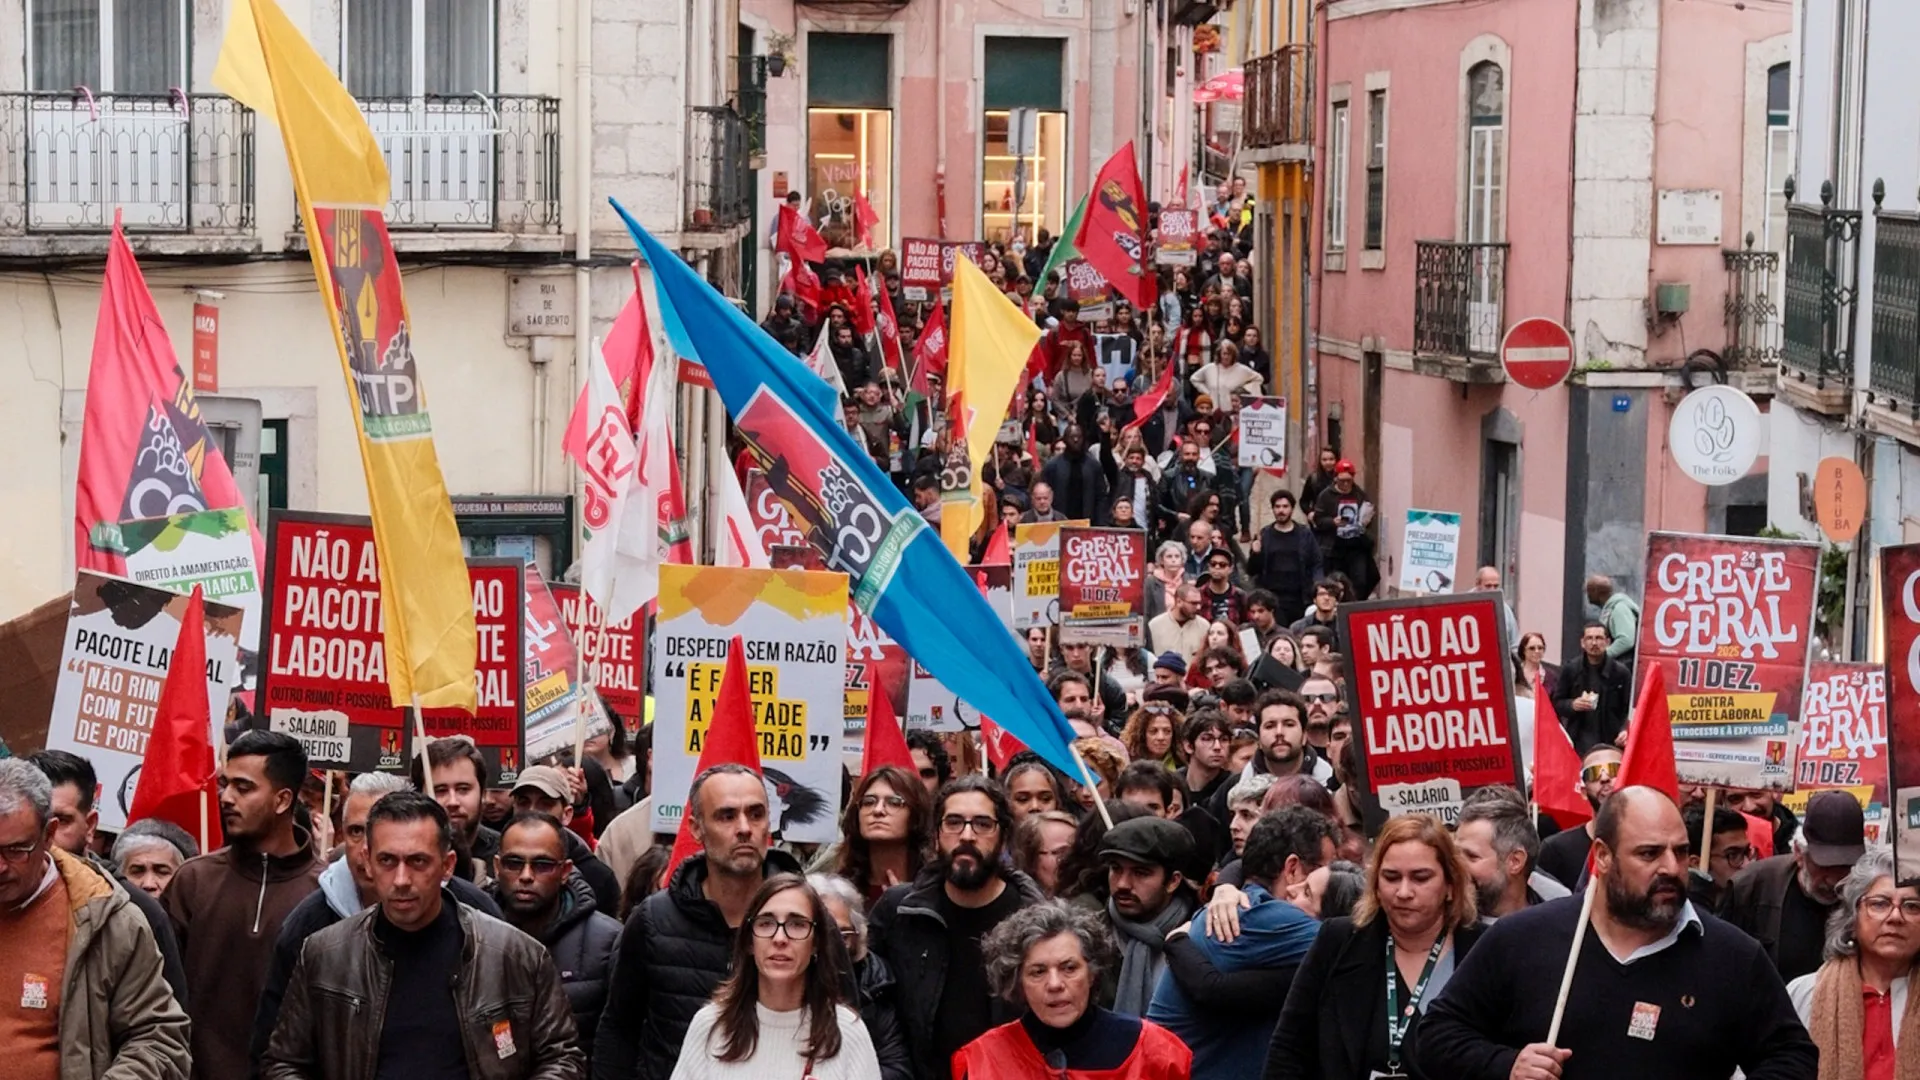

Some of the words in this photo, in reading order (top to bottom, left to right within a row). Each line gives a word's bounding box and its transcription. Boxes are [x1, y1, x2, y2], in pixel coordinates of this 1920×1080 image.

[908, 242, 926, 255] NÃO
[927, 244, 939, 256] AO
[907, 255, 939, 268] PACOTE
[903, 267, 941, 281] LABORAL
[540, 284, 556, 294] RUA
[543, 300, 552, 310] DE
[545, 315, 570, 325] BENTO
[1692, 465, 1711, 475] The
[1712, 465, 1737, 476] Folks
[453, 502, 489, 512] EGUESIA
[490, 503, 502, 512] DA
[290, 530, 348, 582] NÃO
[356, 540, 384, 584] A
[1066, 534, 1133, 563] GREVE
[135, 568, 171, 582] DIREITO
[1066, 556, 1140, 588] GERAL
[1658, 552, 1791, 610] GREVE
[1080, 588, 1093, 602] 11
[284, 584, 384, 635] PACOT
[1367, 614, 1432, 663] NÃO
[1440, 614, 1481, 657] AO
[1654, 595, 1798, 660] GERAL
[74, 628, 145, 666] PACOTE
[147, 643, 224, 684] LAAL
[271, 633, 389, 685] LABORA
[666, 636, 731, 660] DESPEDI
[746, 640, 780, 662] SEM
[785, 640, 837, 664] RAZÃO
[1717, 645, 1740, 658] 2025
[86, 665, 123, 695] NÃO
[128, 677, 161, 703] RIM
[690, 664, 702, 692] É
[709, 668, 774, 696] FER
[1370, 660, 1489, 709] PACOTE
[1678, 659, 1702, 687] 11
[1704, 660, 1761, 692] DEZ.
[531, 684, 566, 710] LABORAL
[1690, 696, 1735, 708] CONTRA
[1805, 671, 1885, 719] REVE
[82, 692, 120, 721] COM
[125, 703, 157, 729] FUT
[690, 698, 702, 722] A
[1670, 708, 1711, 721] PACOTE
[1713, 708, 1765, 720] LABORAL
[76, 718, 101, 745] DE
[105, 727, 151, 753] PORT
[288, 715, 337, 737] SALÁRIO
[1365, 706, 1507, 756] LABORAL
[1733, 724, 1785, 736] EXPLORAÇÃO
[301, 739, 344, 759] IREITOS
[379, 756, 401, 766] CGTP
[1374, 763, 1409, 779] OUTRO
[1410, 761, 1441, 776] RUMO
[1452, 756, 1506, 773] POSSÍVEL!
[1799, 760, 1816, 784] 11
[1820, 761, 1862, 785] DEZ.
[1399, 786, 1449, 806] SALÁRIO
